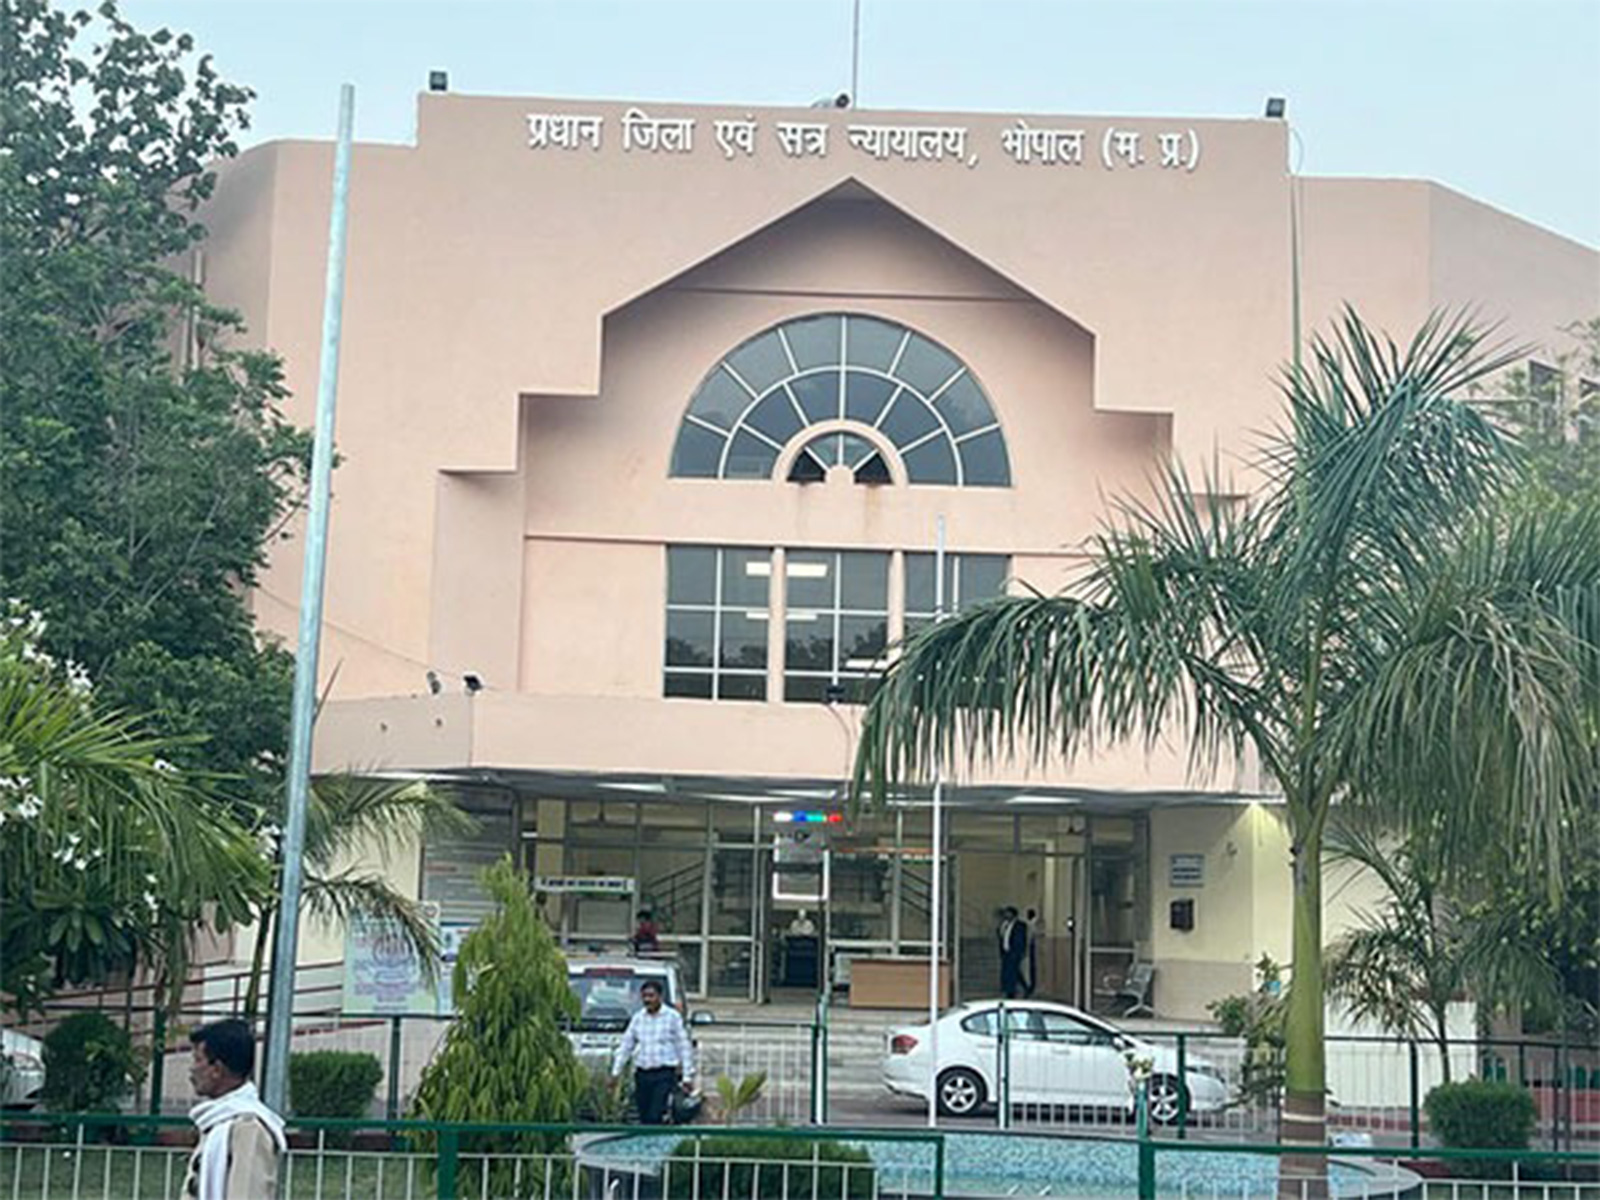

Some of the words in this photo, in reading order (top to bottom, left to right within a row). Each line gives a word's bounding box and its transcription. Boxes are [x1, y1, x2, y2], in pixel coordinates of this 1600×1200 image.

[527, 113, 603, 148] प्रधान
[622, 107, 695, 150] जिला
[714, 115, 757, 157] एवं
[776, 122, 829, 156] सत्र
[847, 124, 978, 167] न्यायालय,
[1001, 118, 1085, 162] भोपाल
[1102, 127, 1145, 168] (म.
